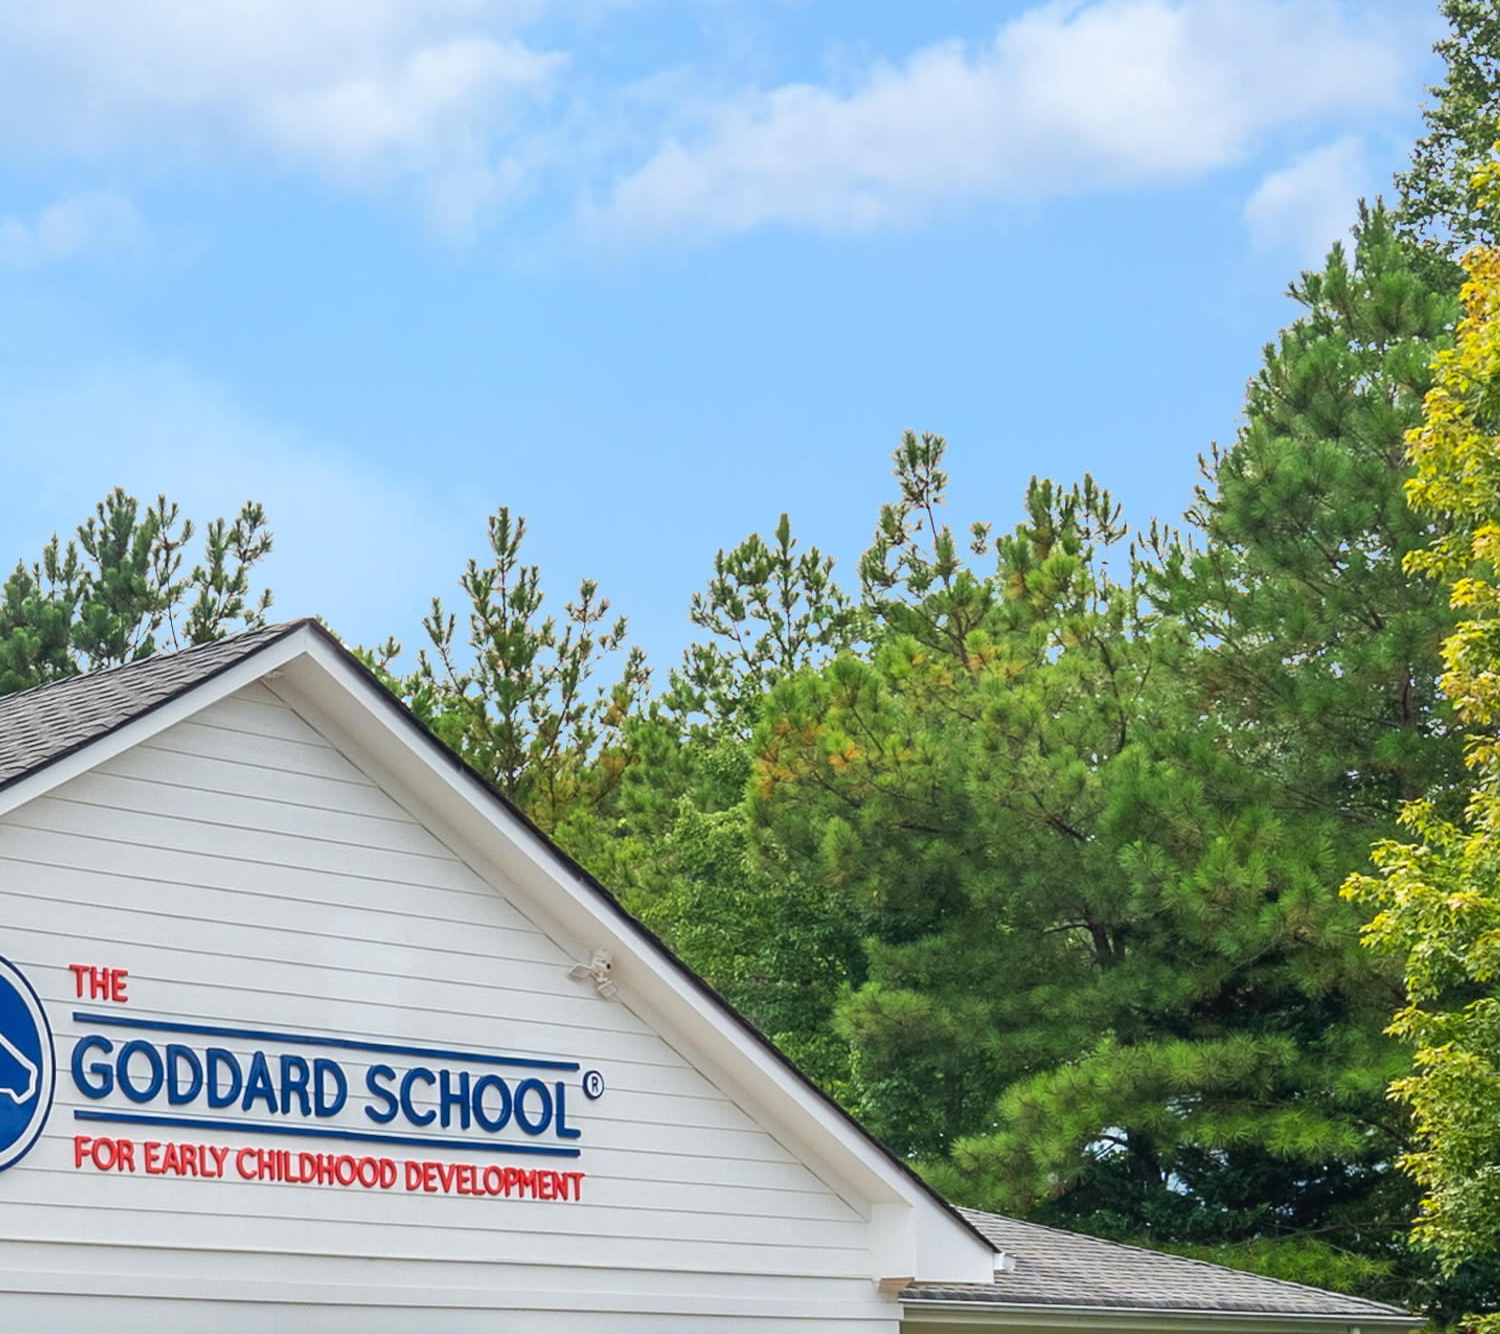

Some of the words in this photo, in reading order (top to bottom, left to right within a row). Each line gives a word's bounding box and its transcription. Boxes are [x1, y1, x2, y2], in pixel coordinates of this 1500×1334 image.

[69, 963, 128, 1002] THE
[71, 1035, 348, 1117] GODDARD
[74, 1135, 136, 1173] FOR
[144, 1141, 230, 1178] EARLY
[236, 1147, 398, 1189] CHILDHOOD
[404, 1161, 586, 1201] DEVELOPMENT
